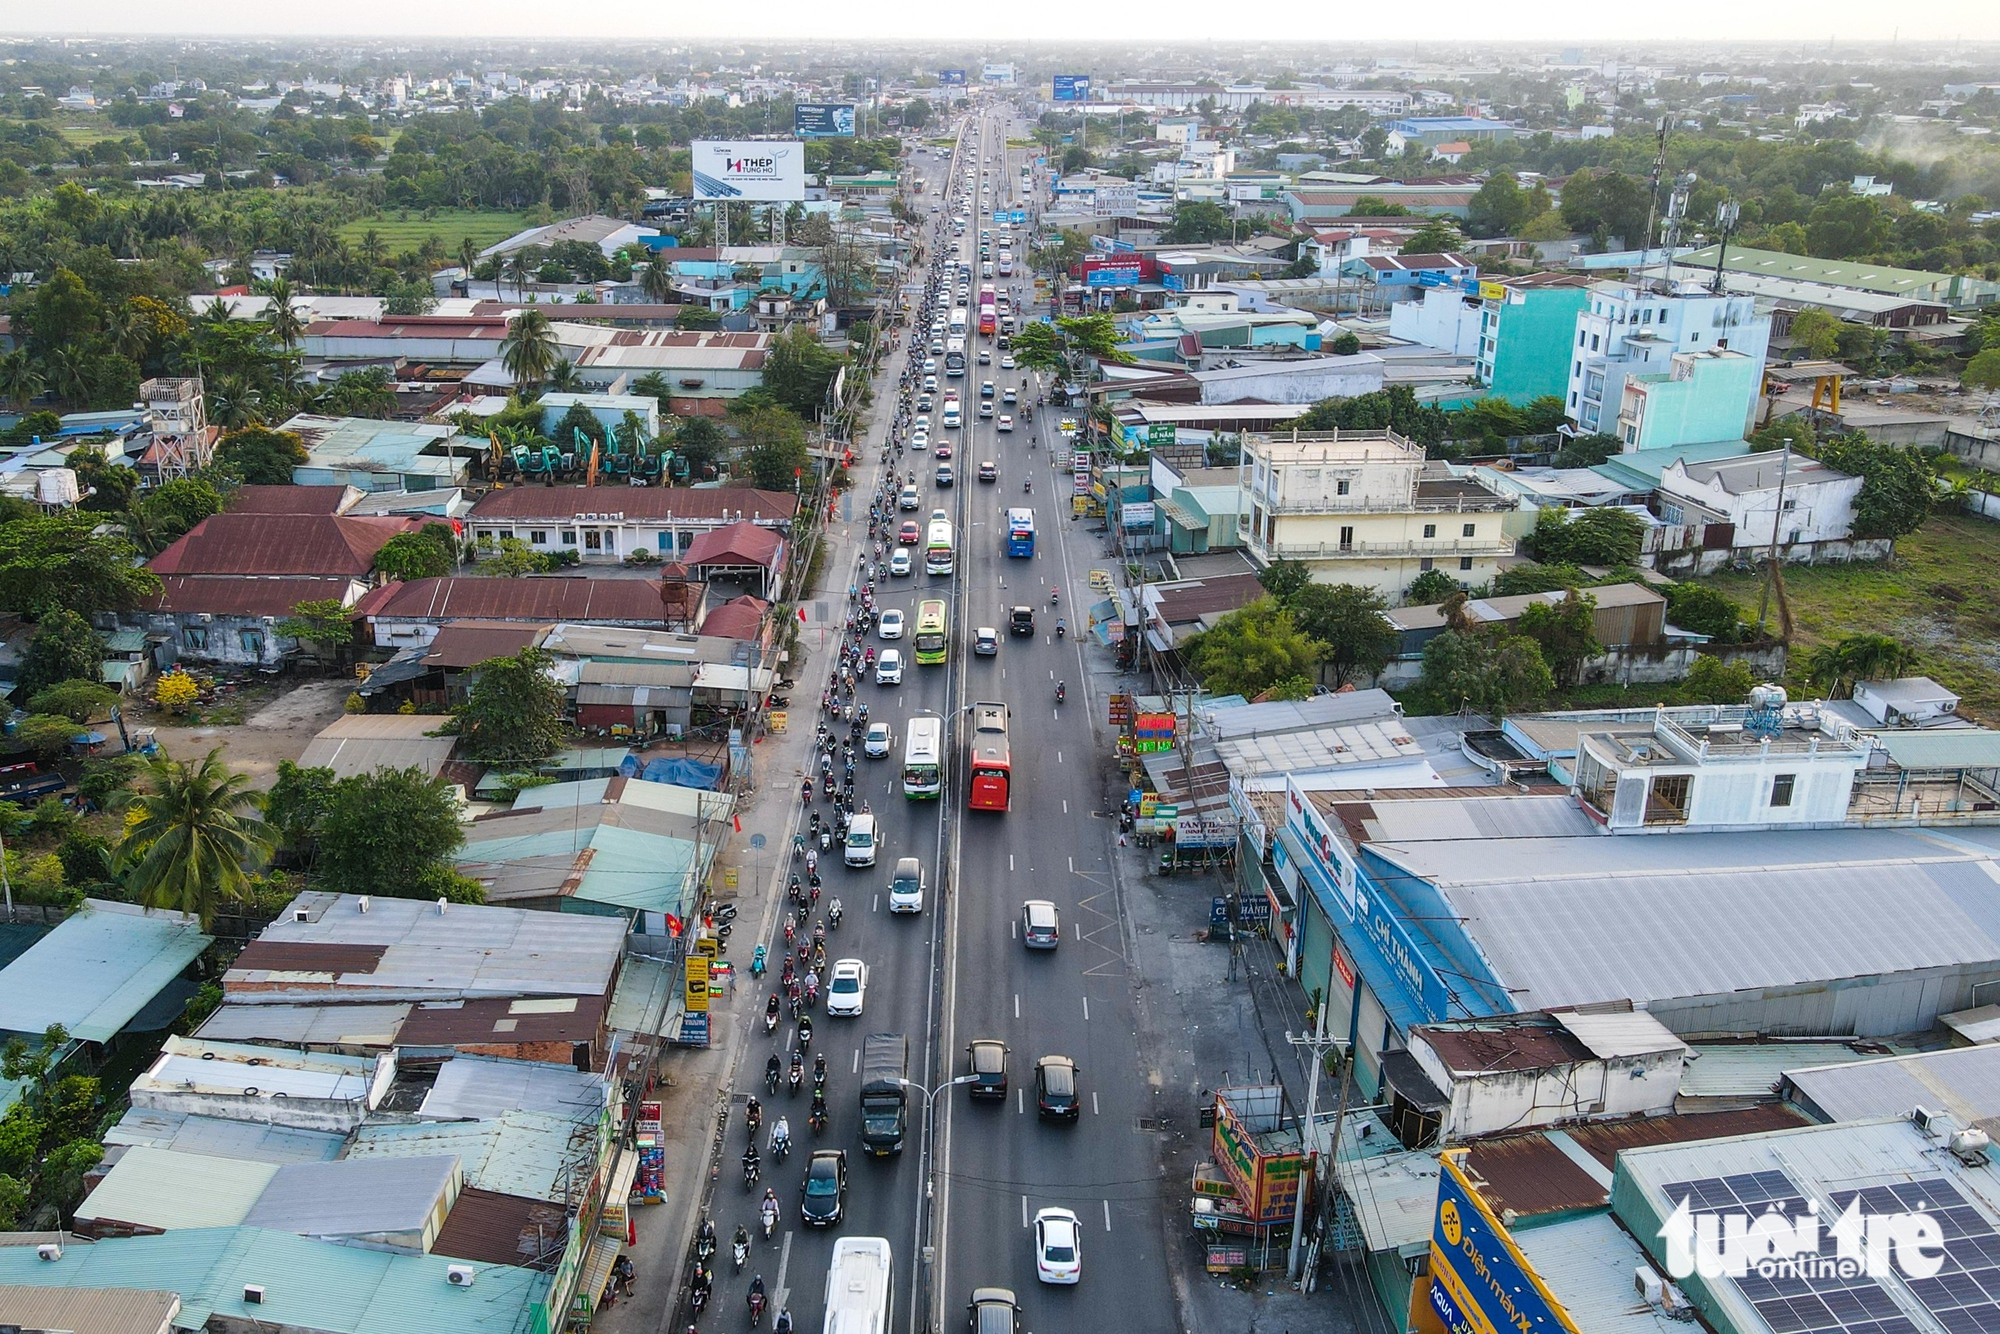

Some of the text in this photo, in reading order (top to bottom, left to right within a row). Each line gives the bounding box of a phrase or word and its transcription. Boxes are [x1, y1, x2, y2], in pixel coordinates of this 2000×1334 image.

[743, 157, 773, 167] THÉP
[1462, 1235, 1491, 1284] Điện
[1430, 1285, 1453, 1322] AQUA
